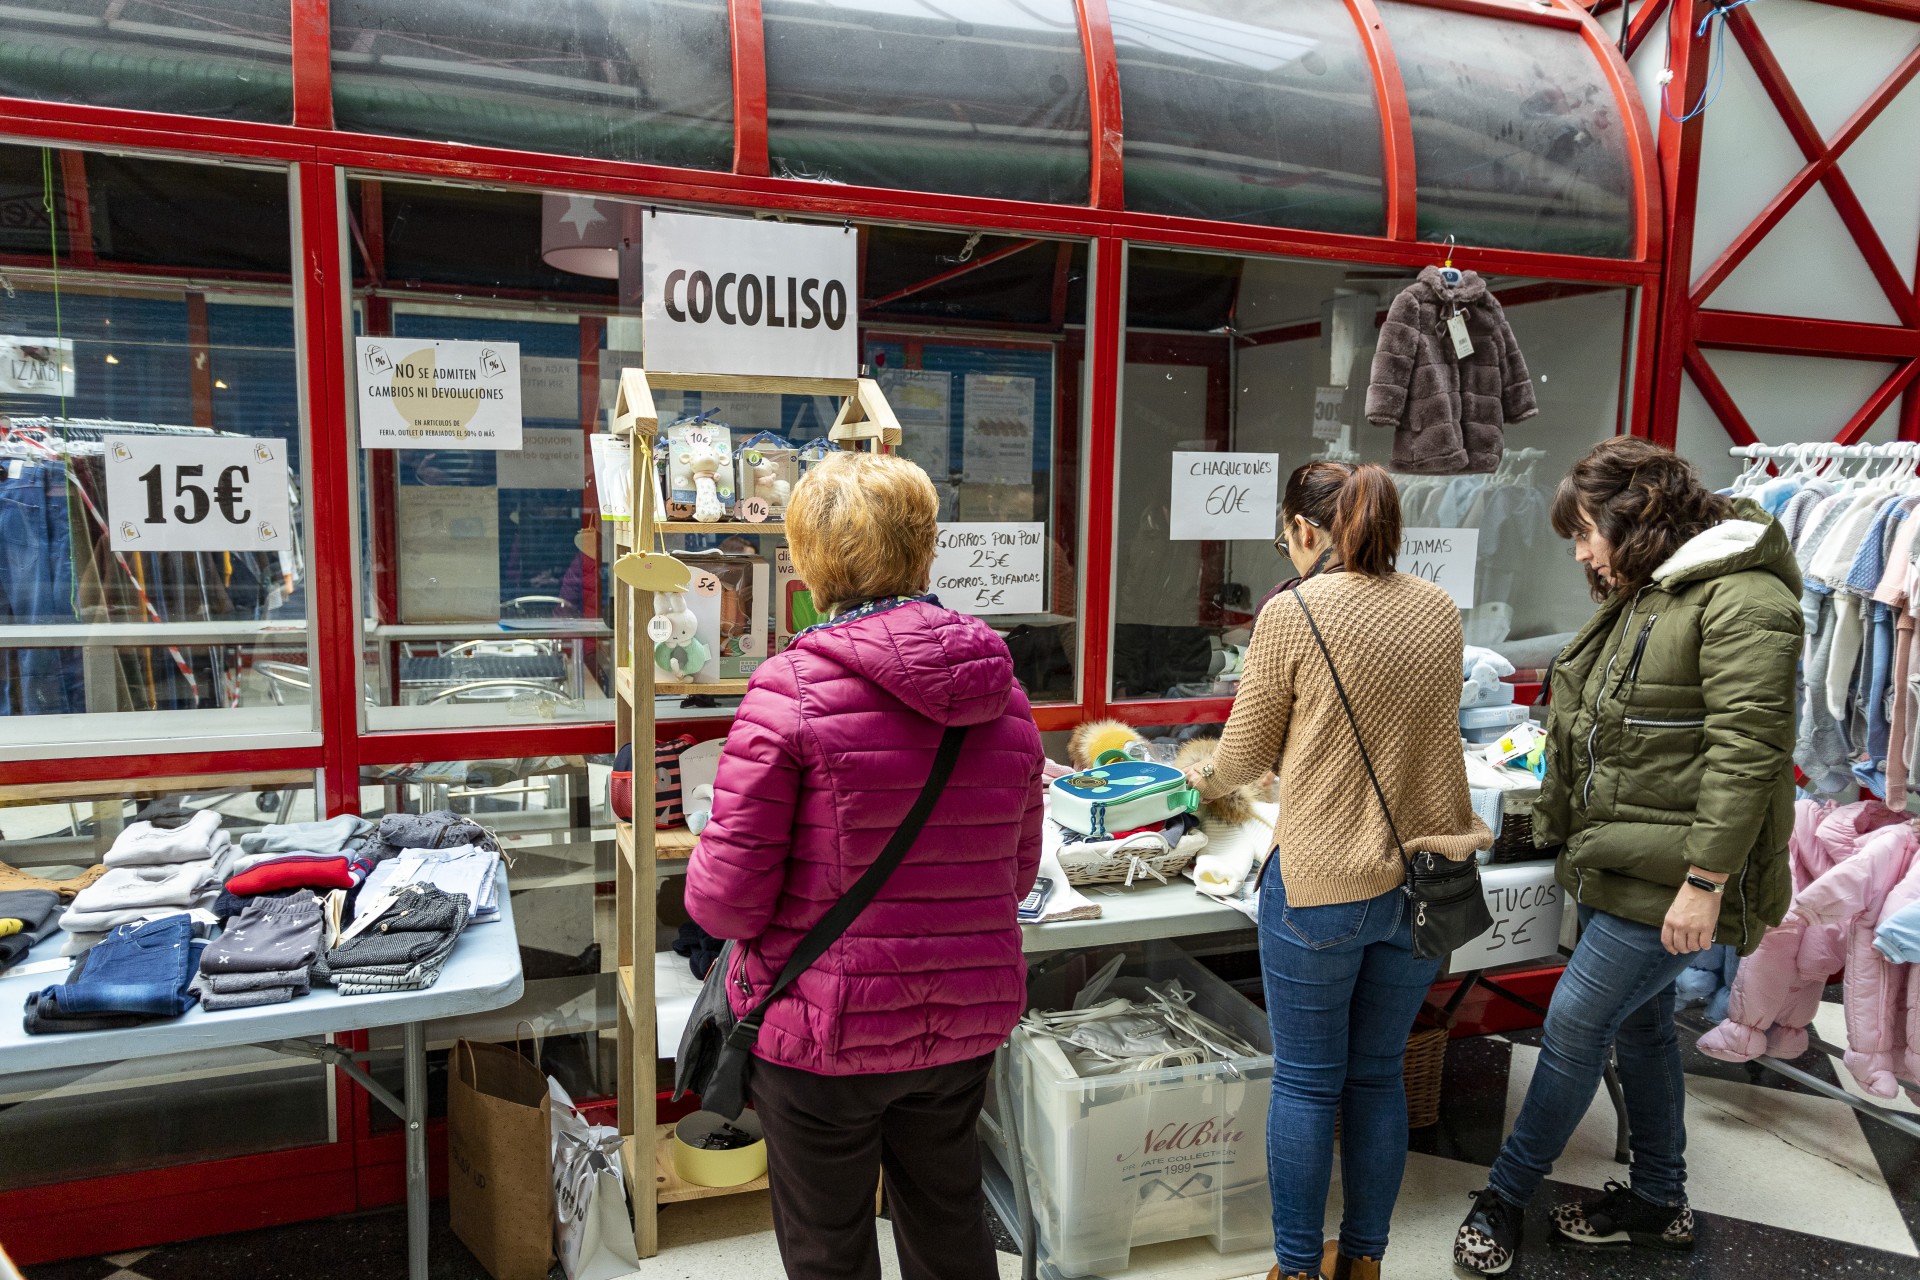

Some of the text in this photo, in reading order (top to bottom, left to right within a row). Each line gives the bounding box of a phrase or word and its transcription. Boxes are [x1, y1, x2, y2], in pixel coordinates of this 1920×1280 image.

[664, 269, 847, 330] COCOLISO
[395, 363, 476, 380] NO SE ADMITEN
[368, 385, 504, 400] CAMBIOS NI DEVOLUCIONES
[423, 419, 452, 427] ARTICULOS
[379, 429, 397, 437] FERIA,
[398, 429, 419, 437] OUTLET
[419, 429, 424, 437] O
[425, 429, 456, 437] REBAJADOS
[483, 428, 495, 437] MÁS
[690, 432, 709, 444] 10€
[1190, 459, 1272, 477] CHAQUETONES
[138, 464, 252, 525] 15€
[1205, 485, 1250, 515] 60€
[747, 502, 766, 516] 10€
[936, 529, 1040, 549] GORROS PON PON
[969, 549, 1010, 568] 25€
[777, 565, 796, 574] wa
[698, 577, 716, 591] 5€
[990, 573, 1040, 586] BUFANDAS
[974, 588, 1005, 608] 5€
[1488, 884, 1557, 913] TUCOS
[1486, 916, 1537, 951] 5€
[1122, 1149, 1236, 1173] PRATE COLLECTON
[1164, 1163, 1191, 1176] 1999
